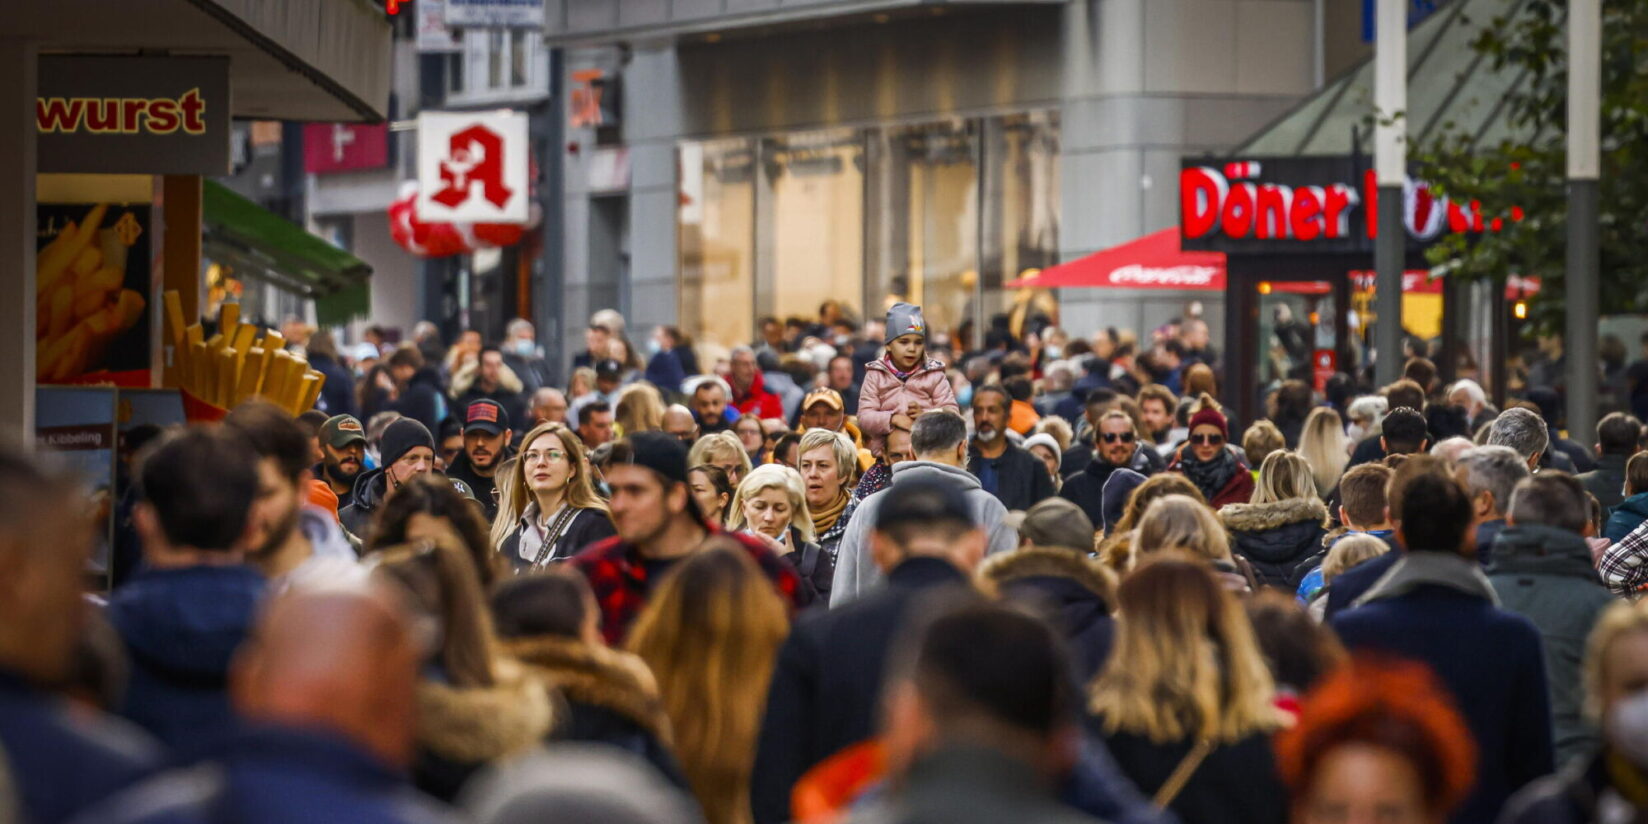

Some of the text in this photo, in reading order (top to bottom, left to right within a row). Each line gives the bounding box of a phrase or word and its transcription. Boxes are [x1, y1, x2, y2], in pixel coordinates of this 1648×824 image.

[37, 87, 206, 134] wurst
[1180, 161, 1358, 240] Döner
[48, 431, 102, 446] Kibbeling
